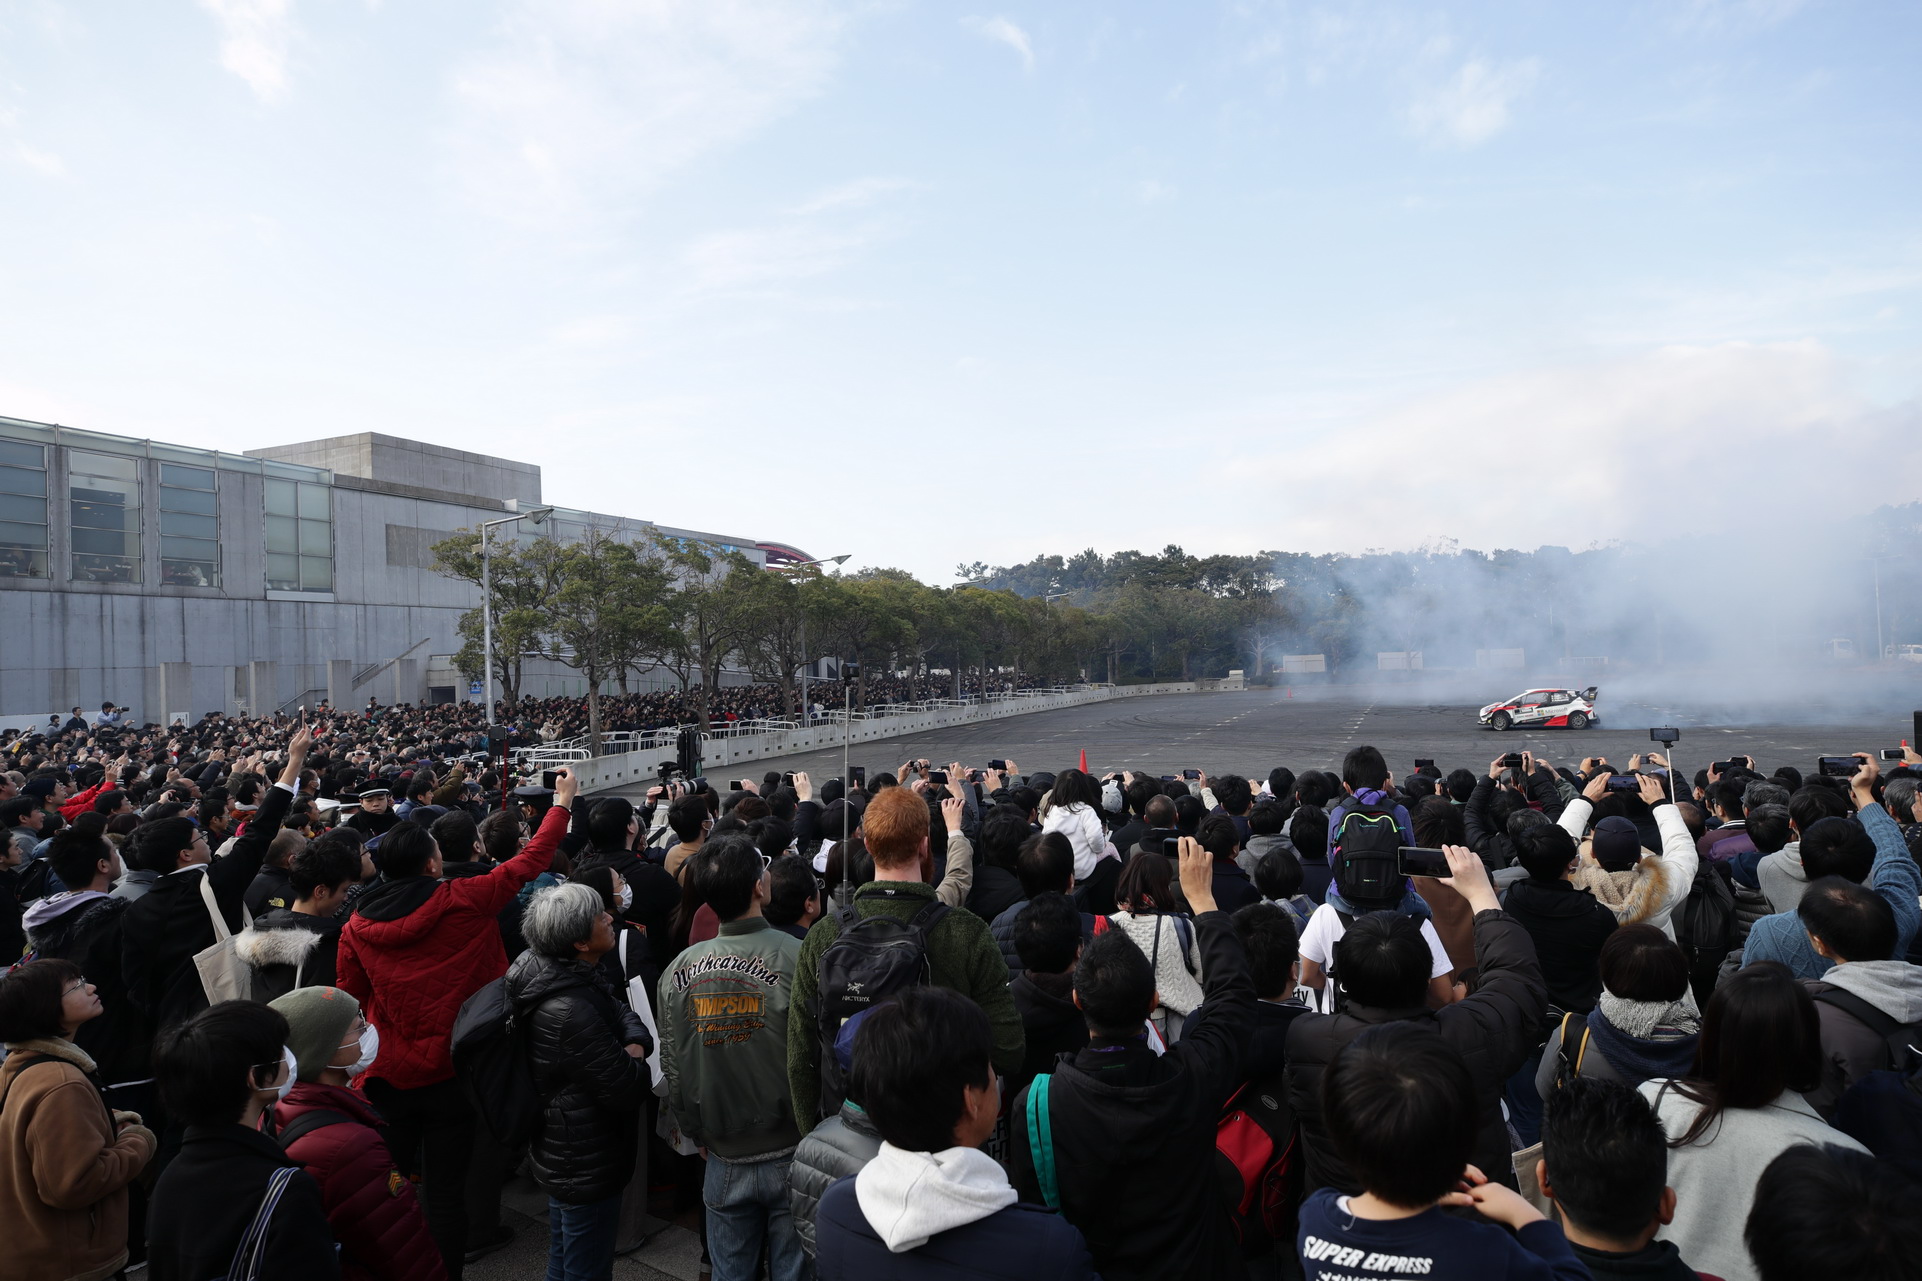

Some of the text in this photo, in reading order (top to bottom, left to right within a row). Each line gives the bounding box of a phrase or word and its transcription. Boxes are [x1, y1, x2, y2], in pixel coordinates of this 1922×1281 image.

[1292, 988, 1309, 1004] rty
[1303, 1235, 1365, 1268] SUPER
[1361, 1252, 1434, 1275] EXPRESS
